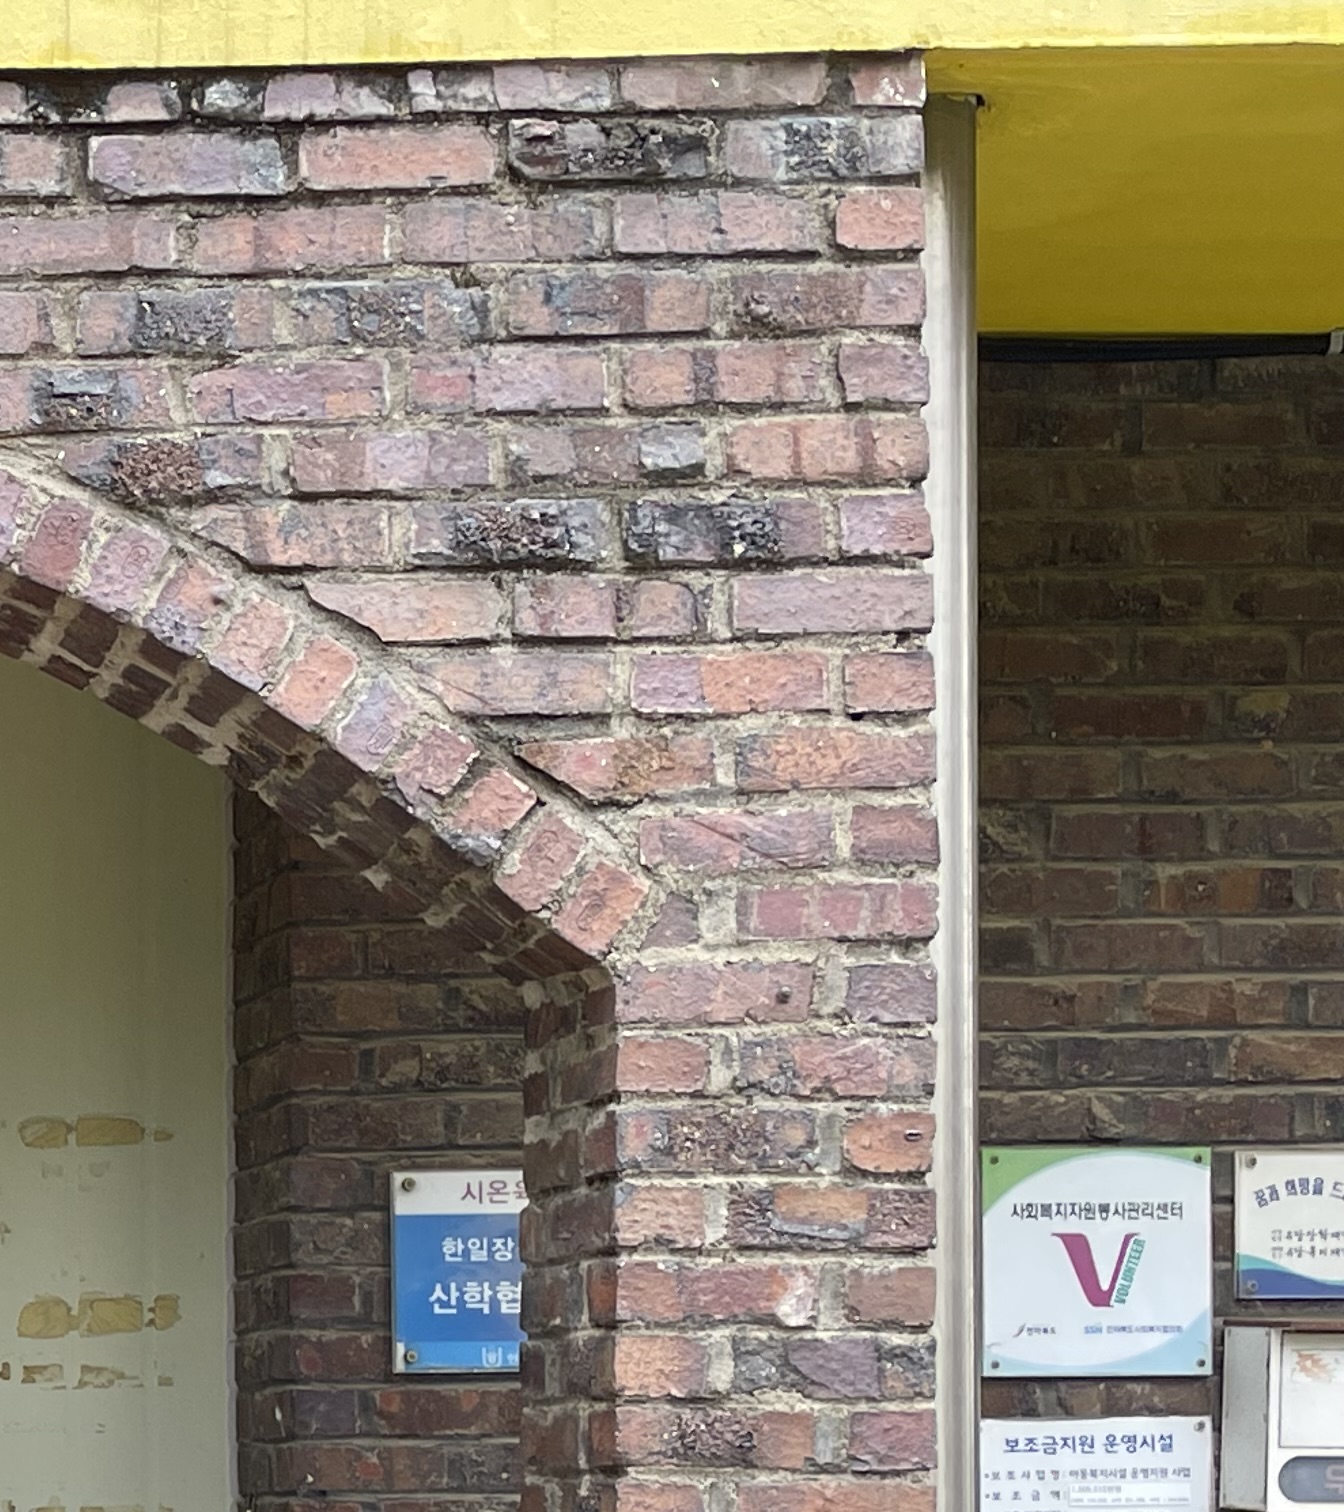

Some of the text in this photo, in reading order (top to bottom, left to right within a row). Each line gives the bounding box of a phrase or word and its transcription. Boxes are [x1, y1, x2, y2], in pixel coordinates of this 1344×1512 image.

[1011, 1202, 1184, 1221] 사회복지자원봉사관리센터
[441, 1236, 515, 1262] 한일장
[1113, 1238, 1146, 1305] VOLUNTEER
[1002, 1433, 1174, 1456] 보조금지원 운영시설
